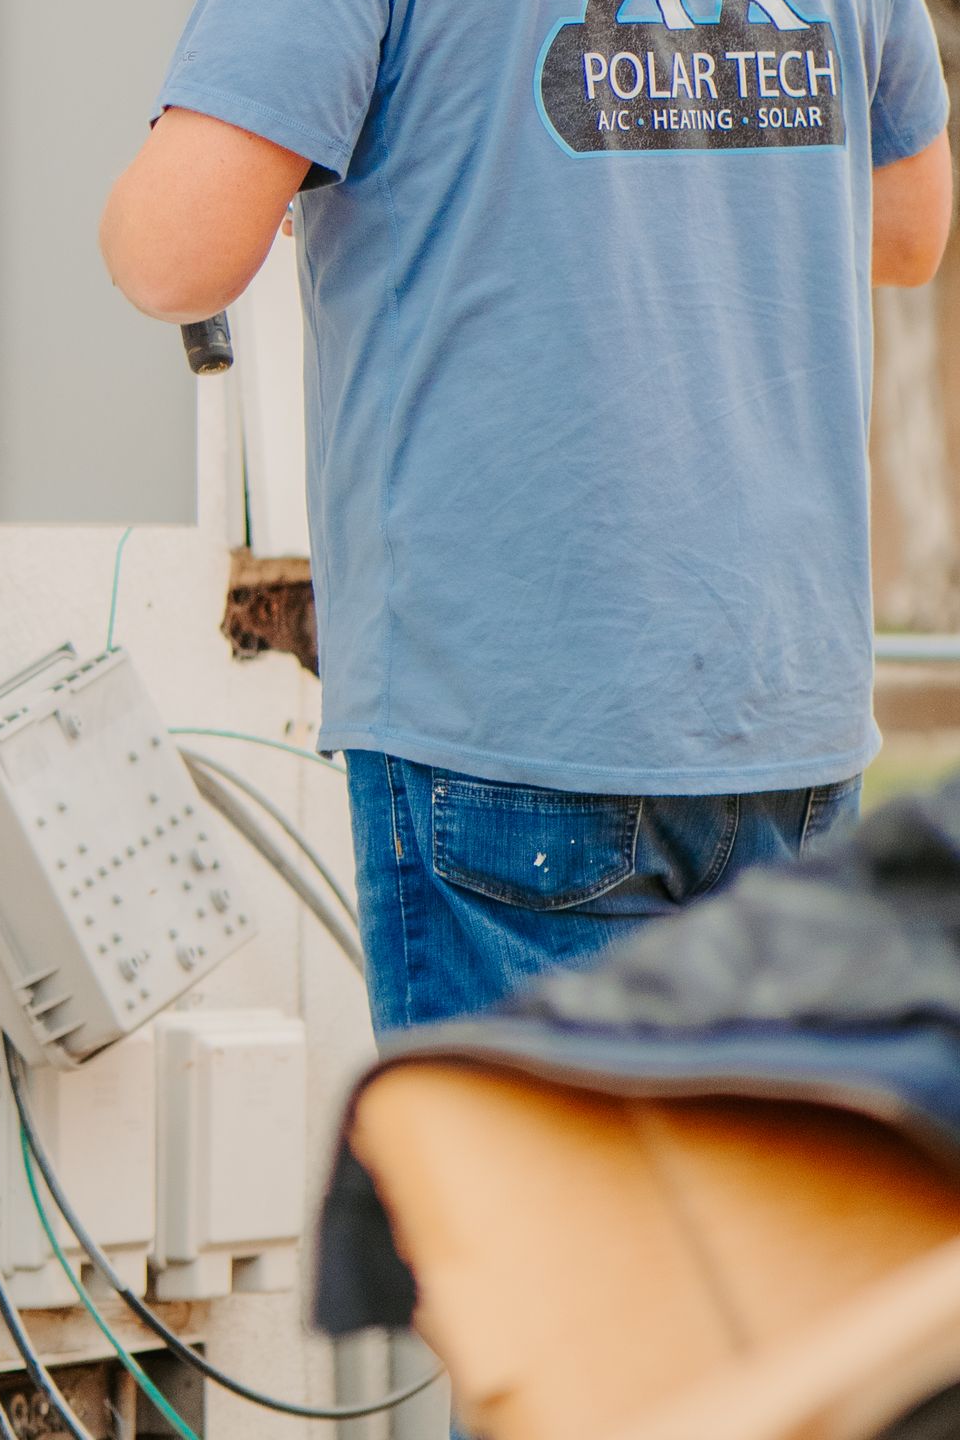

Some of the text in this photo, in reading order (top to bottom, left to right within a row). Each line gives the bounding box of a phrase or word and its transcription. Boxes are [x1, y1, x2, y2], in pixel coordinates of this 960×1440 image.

[583, 49, 837, 100] POLAR TECH
[597, 106, 823, 131] A/C HEATING SOLAR
